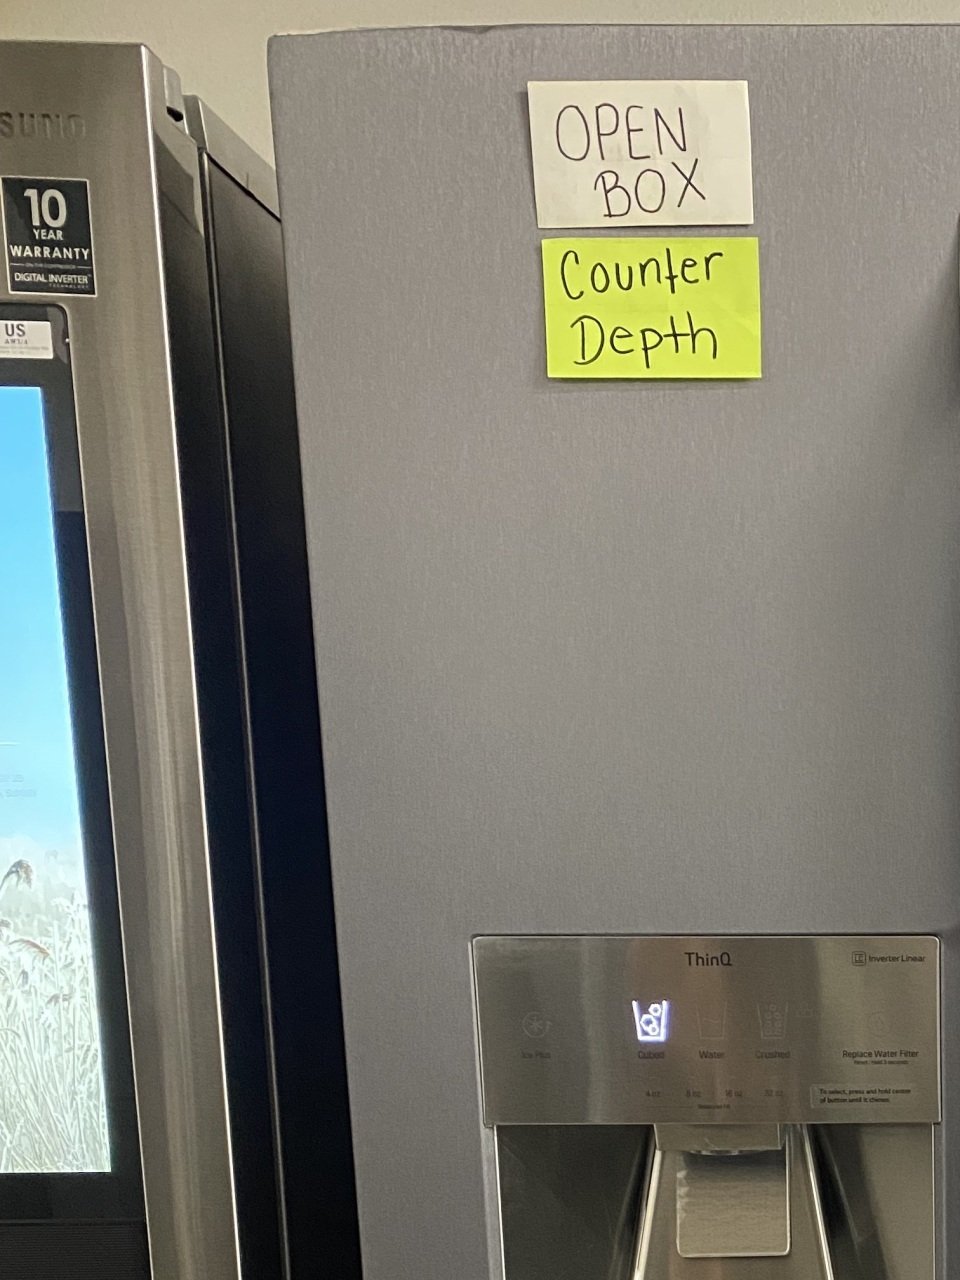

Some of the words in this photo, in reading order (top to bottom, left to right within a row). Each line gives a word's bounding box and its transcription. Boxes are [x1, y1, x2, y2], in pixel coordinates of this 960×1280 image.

[555, 102, 687, 161] OPEN
[593, 157, 706, 218] BOX
[23, 188, 67, 228] 10
[33, 228, 64, 240] YEAR
[9, 244, 90, 260] WARRANTY
[14, 272, 48, 283] DIGITAL
[48, 274, 88, 285] INVERTER
[560, 247, 723, 300] Counter
[4, 323, 26, 337] US
[570, 311, 718, 369] Depth
[683, 951, 733, 966] ThinQ
[868, 954, 900, 962] Inverter
[901, 954, 926, 962] Linear
[699, 1050, 725, 1060] Water
[755, 1050, 791, 1060] Crushed
[842, 1050, 873, 1059] Replace
[874, 1050, 898, 1058] Water
[899, 1050, 920, 1058] Filter
